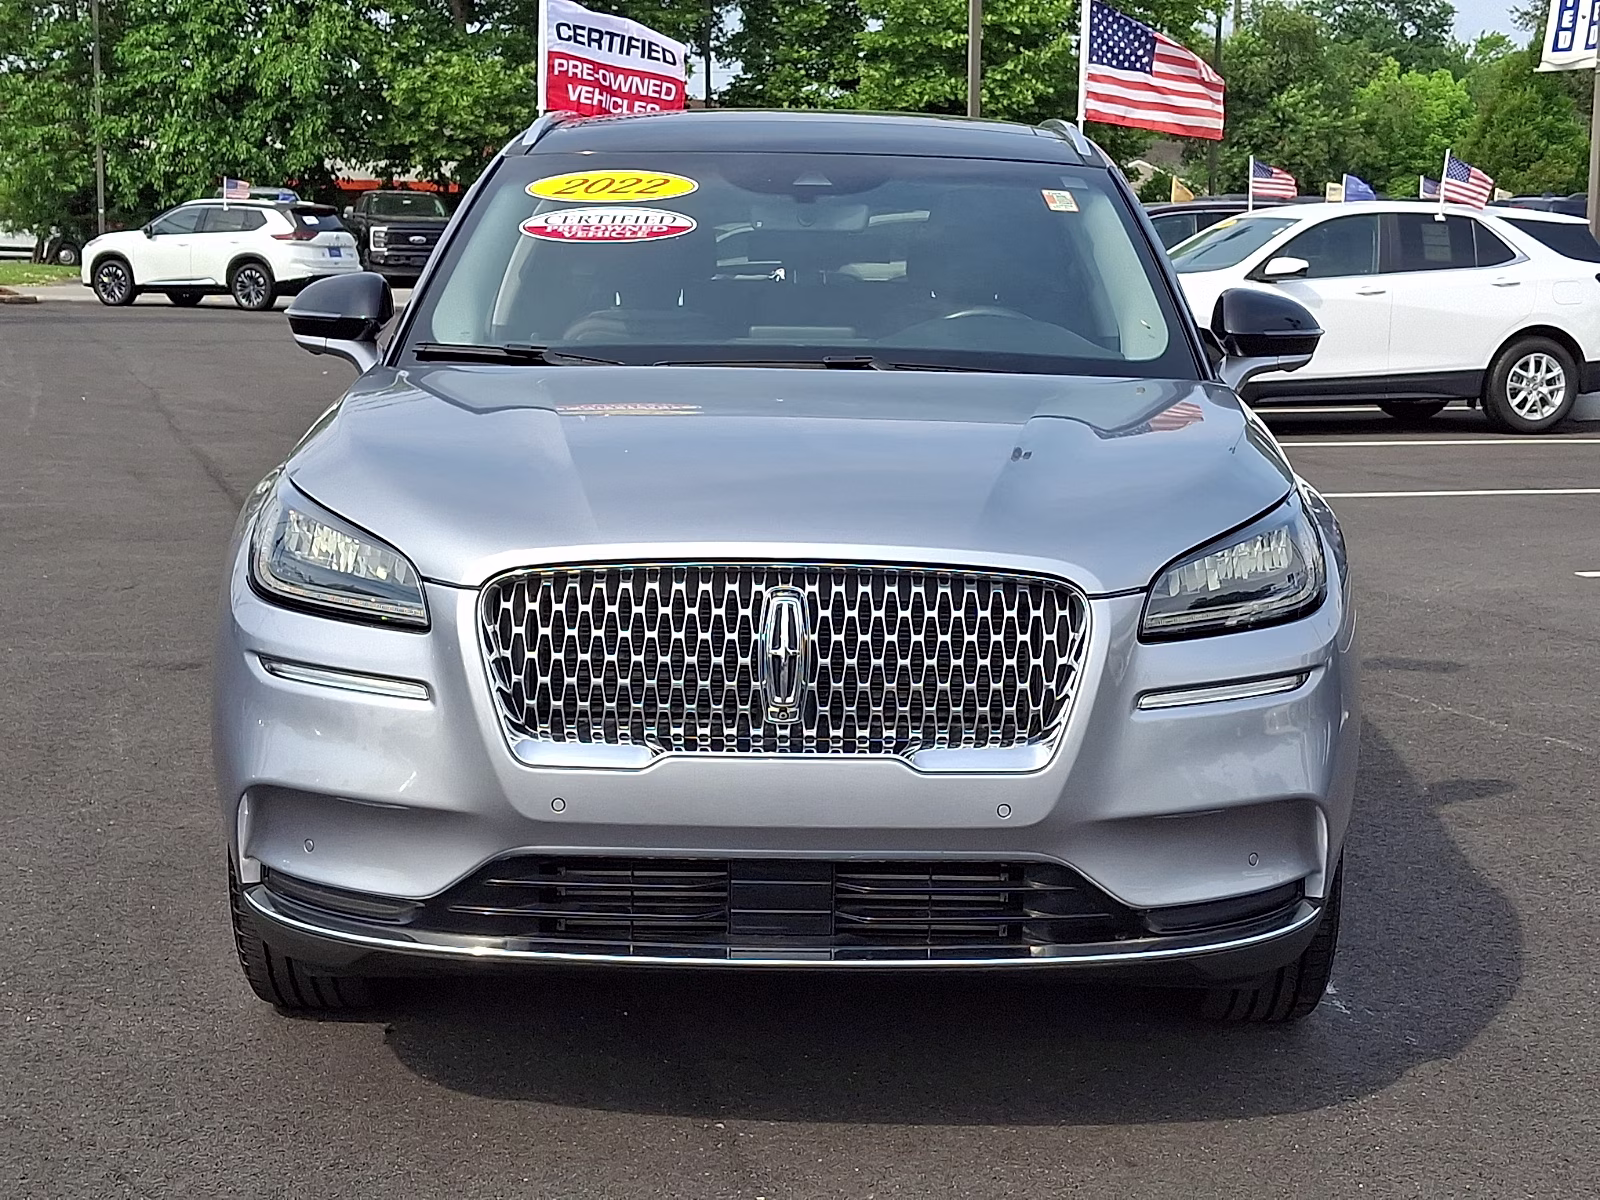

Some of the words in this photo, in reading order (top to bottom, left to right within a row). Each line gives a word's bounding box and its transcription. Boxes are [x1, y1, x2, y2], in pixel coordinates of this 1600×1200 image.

[555, 22, 677, 66] CERTIFIED
[554, 58, 677, 101] PRE-OWNED
[552, 177, 671, 195] 2022
[544, 214, 677, 225] CERTIFIED
[545, 225, 669, 233] PRE-OWNED
[562, 230, 649, 238] VEHICLE
